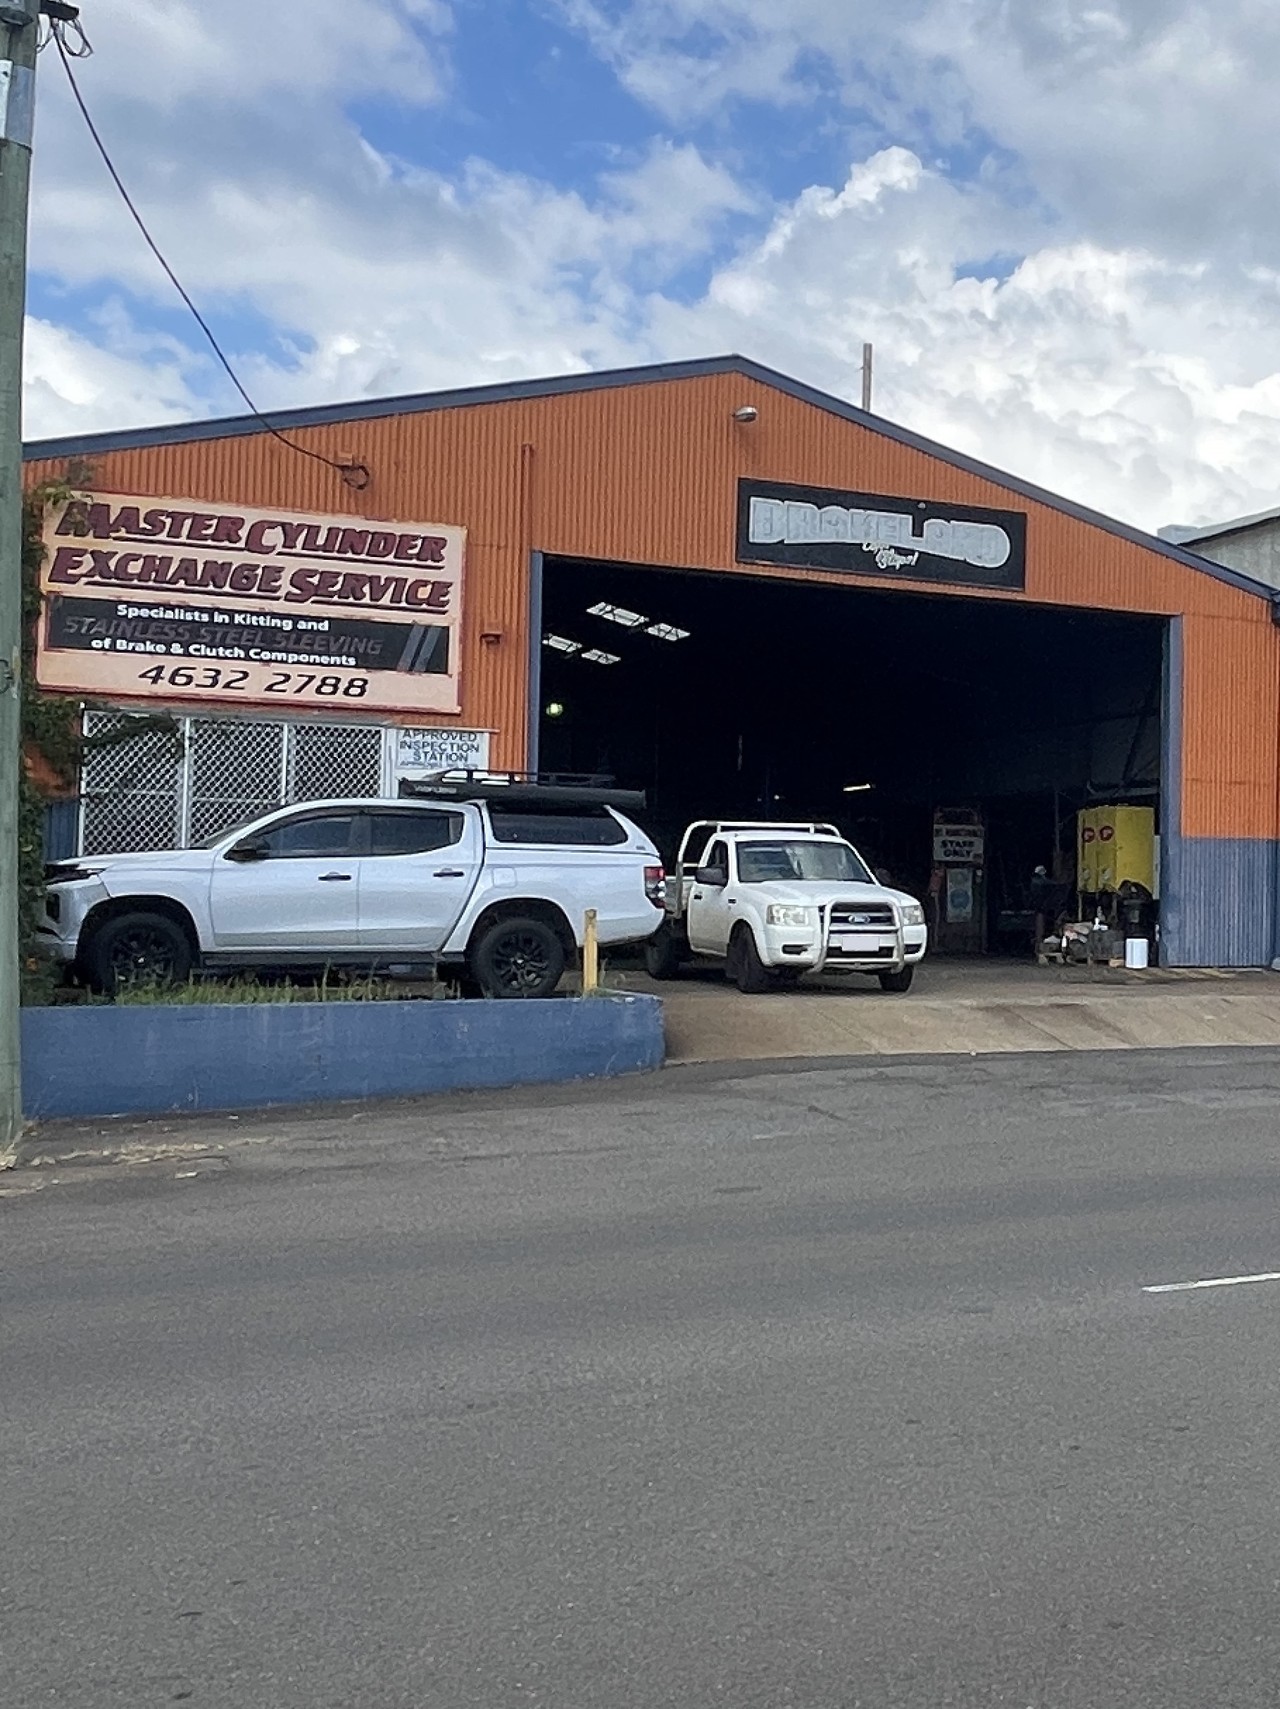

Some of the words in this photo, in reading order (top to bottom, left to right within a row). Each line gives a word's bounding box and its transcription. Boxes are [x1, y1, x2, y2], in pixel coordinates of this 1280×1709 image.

[54, 501, 245, 544] MASTER
[245, 519, 447, 563] CYLINDER
[48, 546, 285, 594] EXCHANGE
[284, 568, 453, 608] SERVICE
[117, 604, 209, 622] Specialists
[213, 611, 230, 624] in
[234, 613, 293, 631] Kitting
[297, 620, 329, 632] and
[91, 637, 112, 650] of
[116, 639, 166, 654] Brake
[170, 642, 184, 655] &
[188, 643, 246, 659] Clutch
[249, 648, 357, 667] Components
[138, 664, 250, 690] 4632
[264, 672, 369, 698] 2788
[403, 729, 477, 742] APPROVED
[413, 751, 469, 762] STATION
